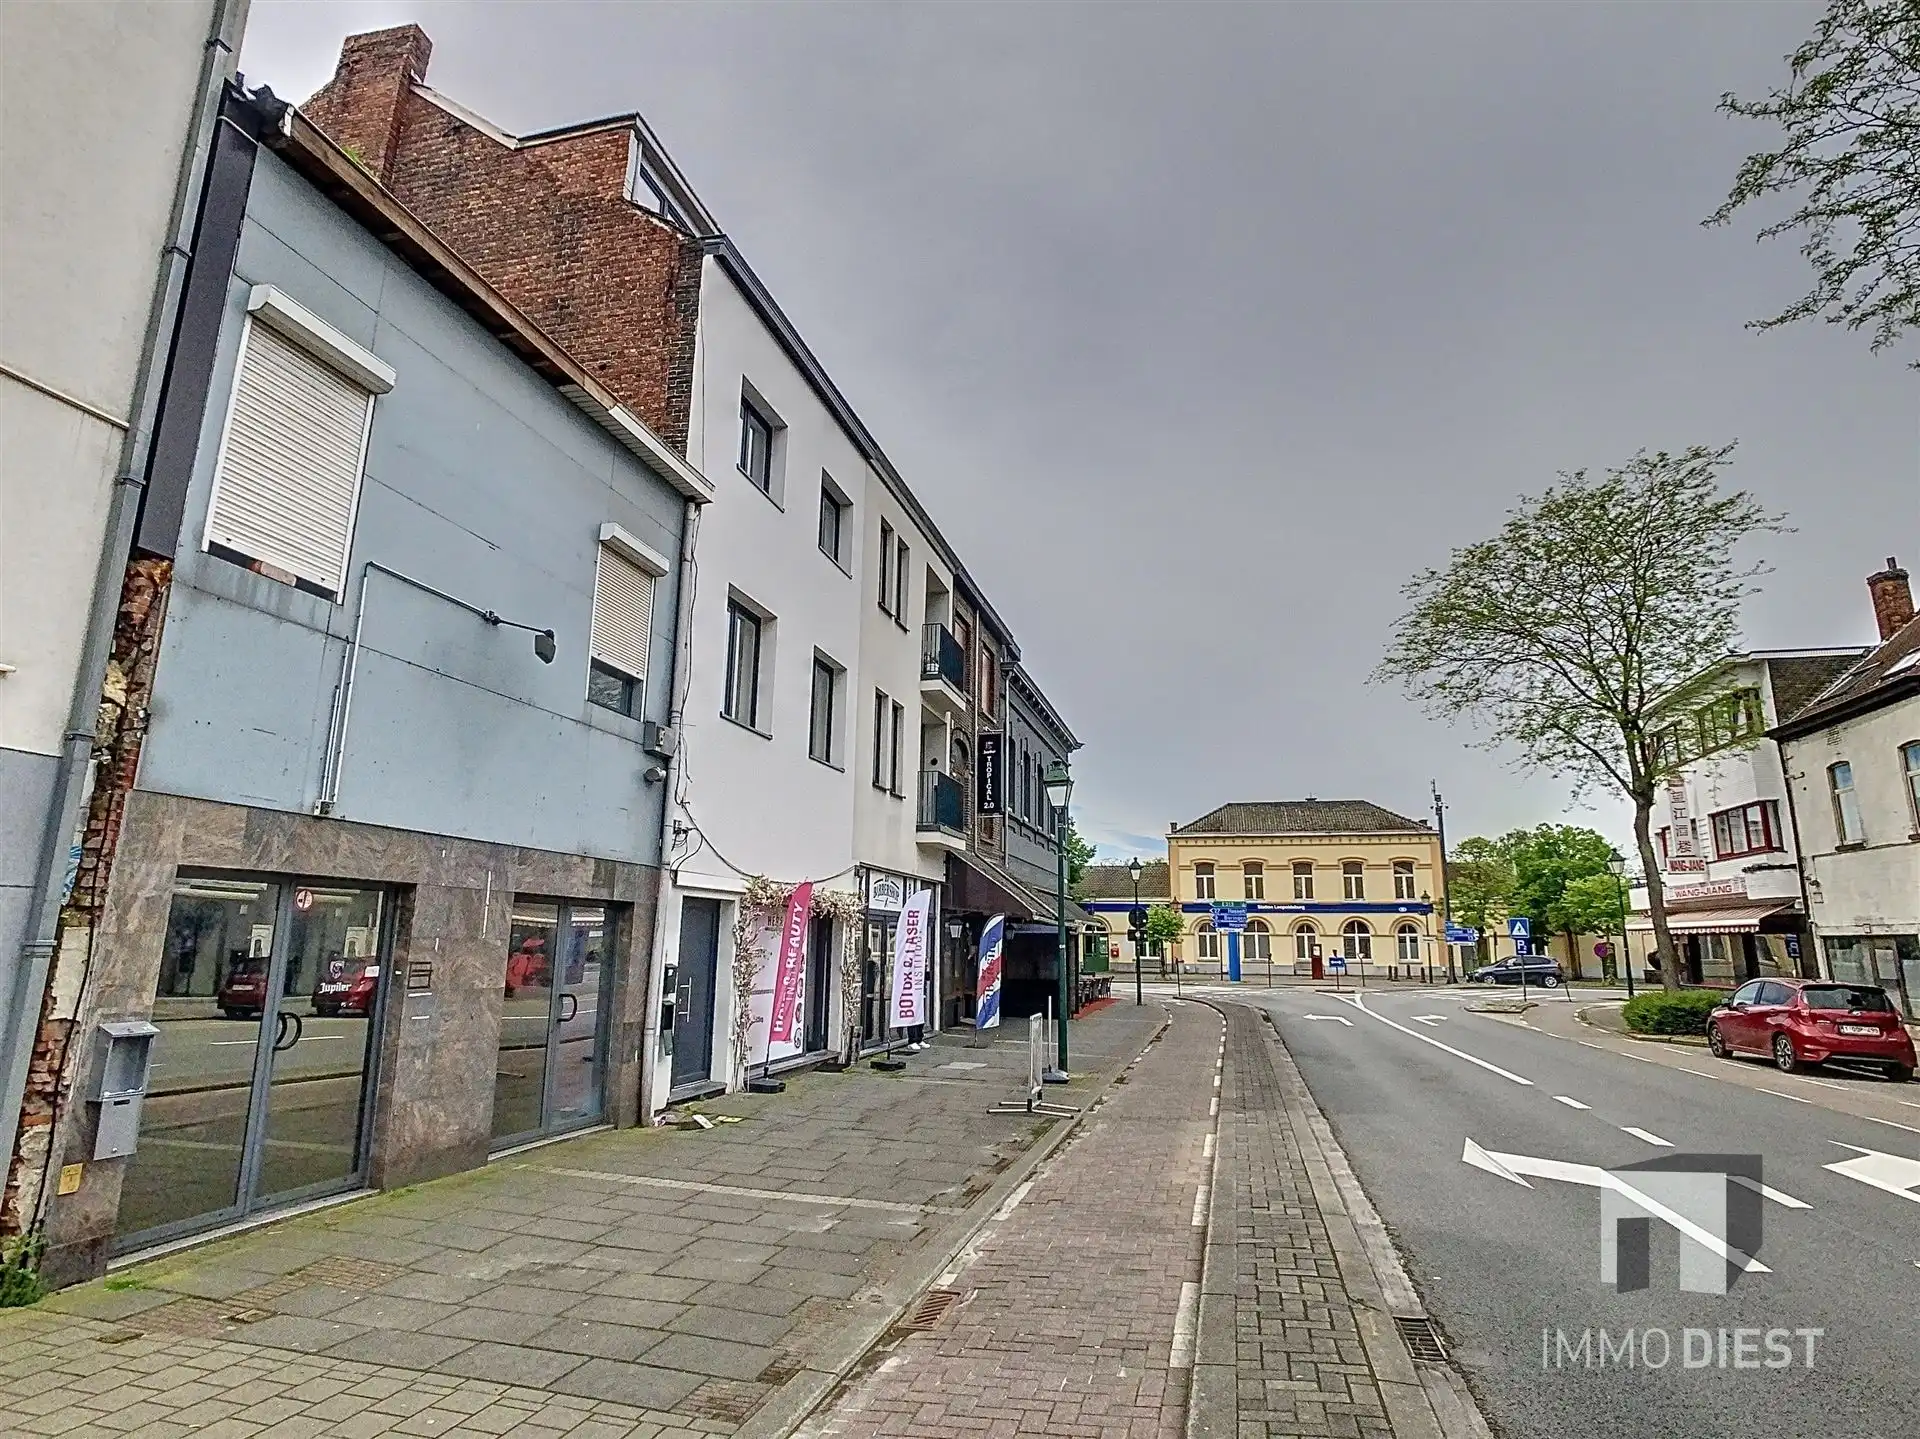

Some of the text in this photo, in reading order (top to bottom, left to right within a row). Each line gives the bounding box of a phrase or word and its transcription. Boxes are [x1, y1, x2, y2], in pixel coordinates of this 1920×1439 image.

[985, 755, 993, 801] TROPICAL
[1675, 885, 1732, 898] WANG-JIANG
[914, 930, 923, 991] INSTITUU
[318, 981, 352, 995] Jupiler
[899, 971, 915, 1019] BOTOX
